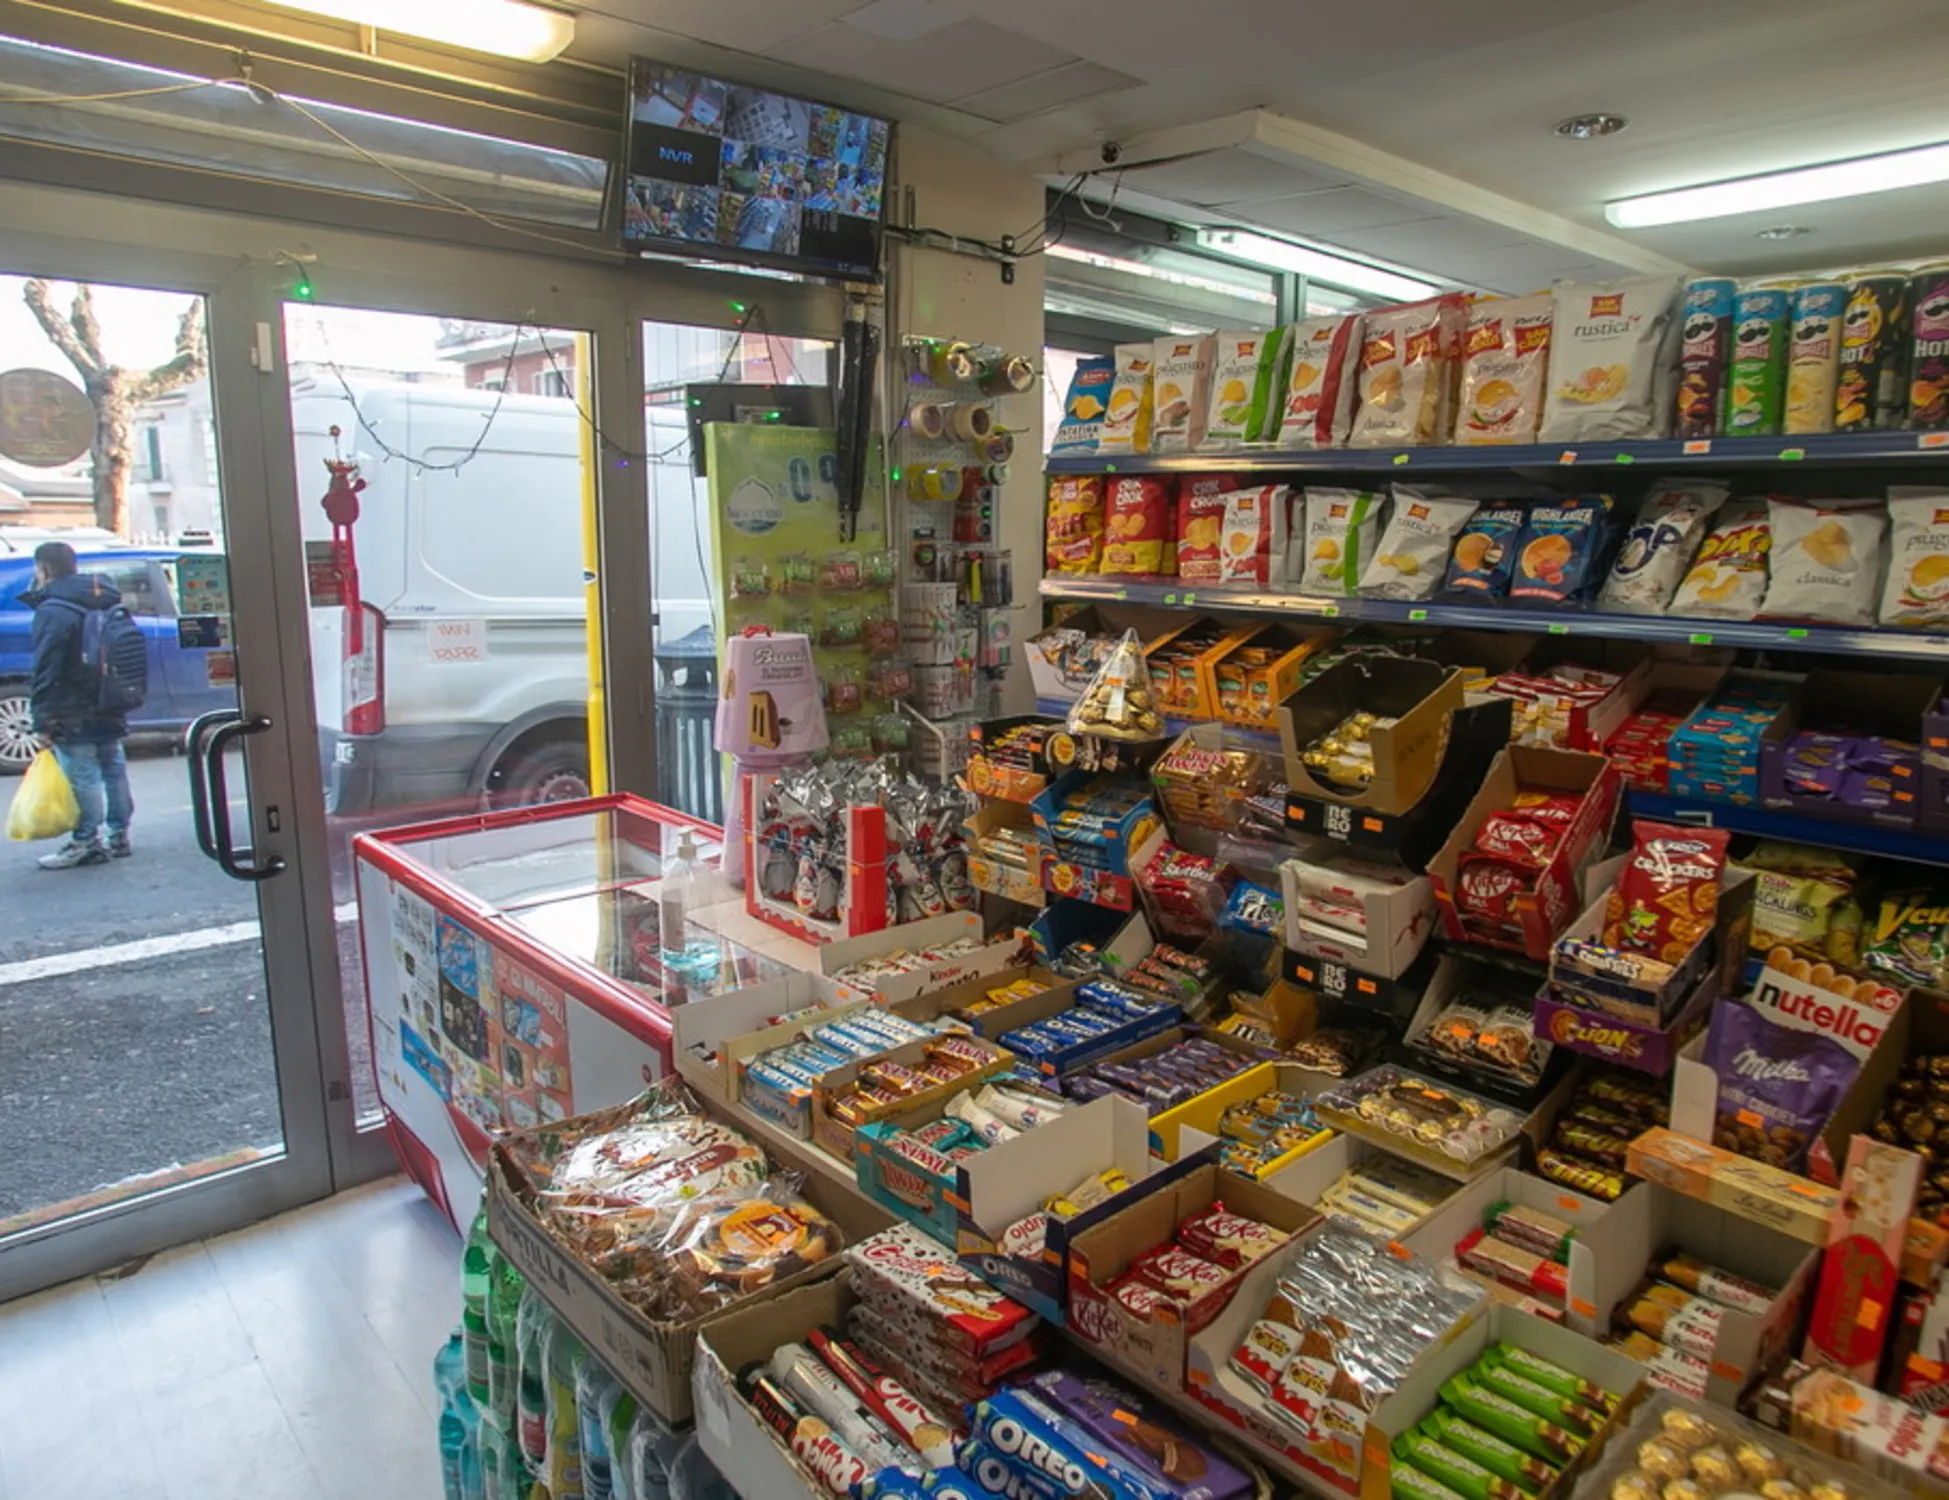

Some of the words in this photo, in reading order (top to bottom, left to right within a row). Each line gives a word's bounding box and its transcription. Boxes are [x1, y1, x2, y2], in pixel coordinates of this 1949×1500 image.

[658, 147, 694, 164] NVR
[1574, 318, 1632, 338] rustica
[1531, 508, 1594, 528] HIGHLANDER
[1162, 863, 1216, 882] Skittles
[1757, 981, 1884, 1049] nutella
[1577, 1025, 1628, 1051] LION
[1732, 1047, 1812, 1083] Milka
[1205, 1214, 1269, 1241] KitKat
[982, 1256, 1036, 1289] OREO
[1157, 1253, 1222, 1284] KitKat
[1072, 1301, 1123, 1342] KitKat
[988, 1417, 1086, 1490] OREO
